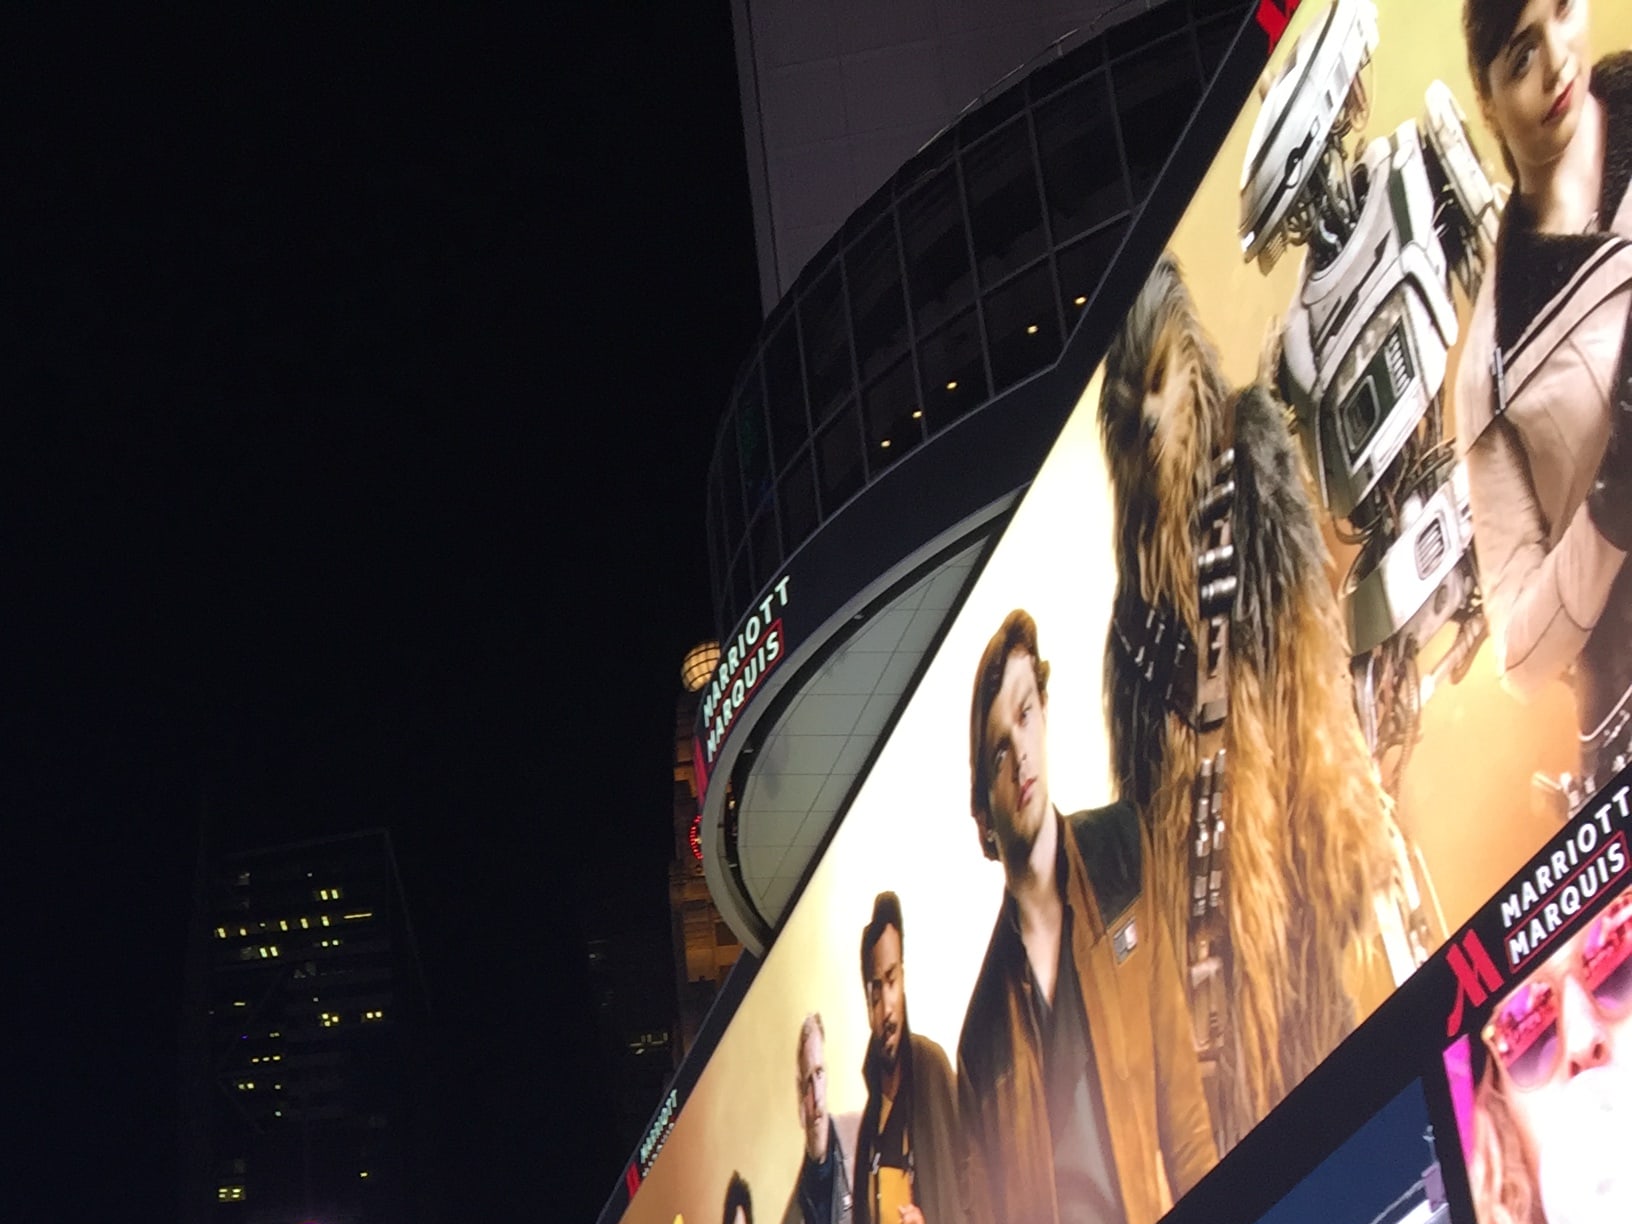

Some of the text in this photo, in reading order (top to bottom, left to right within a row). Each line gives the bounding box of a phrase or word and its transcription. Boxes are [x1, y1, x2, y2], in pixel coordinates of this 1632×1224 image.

[703, 575, 790, 727] MARRIOTT
[707, 630, 780, 762] MARQUIS
[1500, 786, 1632, 928] MARRIOTT
[1508, 841, 1627, 966] MARQUIS
